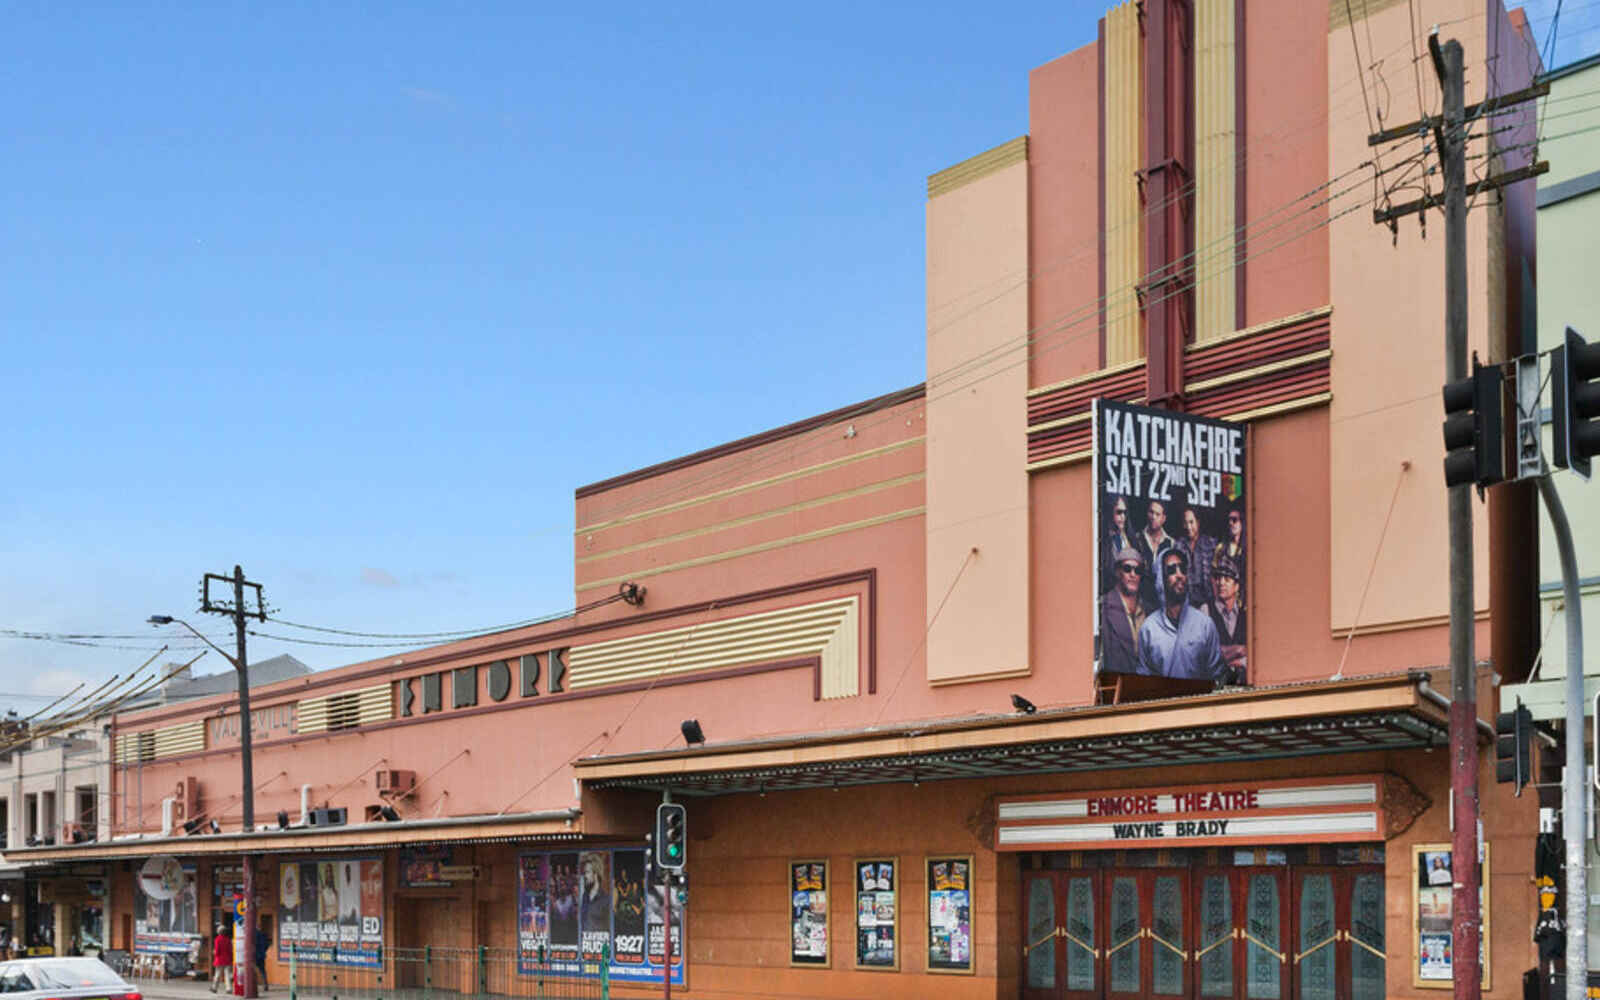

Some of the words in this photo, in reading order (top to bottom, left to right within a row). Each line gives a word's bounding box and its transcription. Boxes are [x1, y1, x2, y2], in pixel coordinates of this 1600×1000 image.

[1105, 408, 1242, 474] KATCHAFIRE
[1106, 455, 1143, 497] SAT
[1187, 467, 1221, 508] SEP
[399, 647, 567, 717] ENMORE
[209, 704, 298, 745] VAUEVILLE
[1087, 795, 1159, 817] ENMORE
[1171, 789, 1260, 813] THEATRE
[1113, 822, 1165, 839] WAYNE
[1175, 820, 1229, 837] BRADY
[362, 916, 380, 934] ED
[615, 935, 644, 952] 1927
